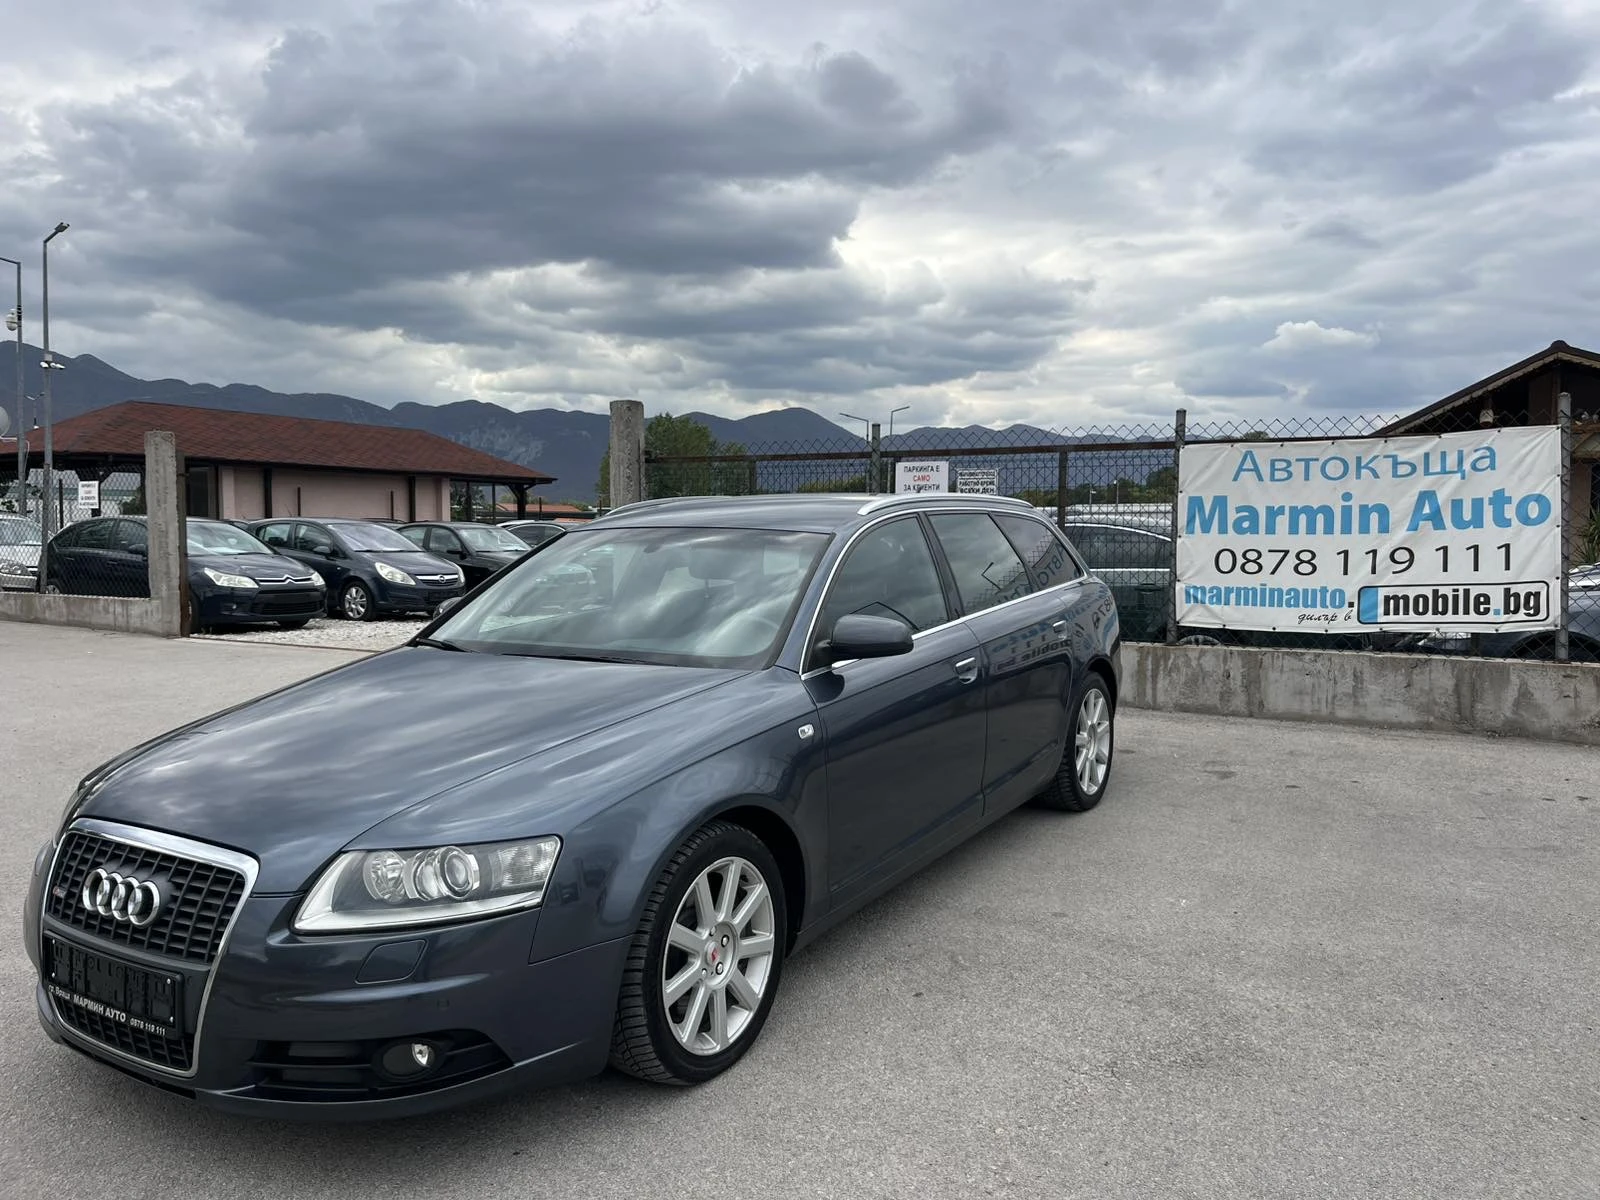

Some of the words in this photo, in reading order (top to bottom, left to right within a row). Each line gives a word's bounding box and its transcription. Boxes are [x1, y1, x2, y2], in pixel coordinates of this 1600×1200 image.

[1232, 446, 1497, 483] Автокъща
[1185, 492, 1390, 535] Marmin
[1406, 488, 1552, 532] Auto
[1214, 548, 1317, 576] 0878
[1336, 546, 1415, 576] 119
[1435, 542, 1511, 572] 111
[1383, 587, 1541, 617] mobile.bg
[73, 994, 104, 1015] МАРМИН
[105, 1008, 126, 1022] АУТО
